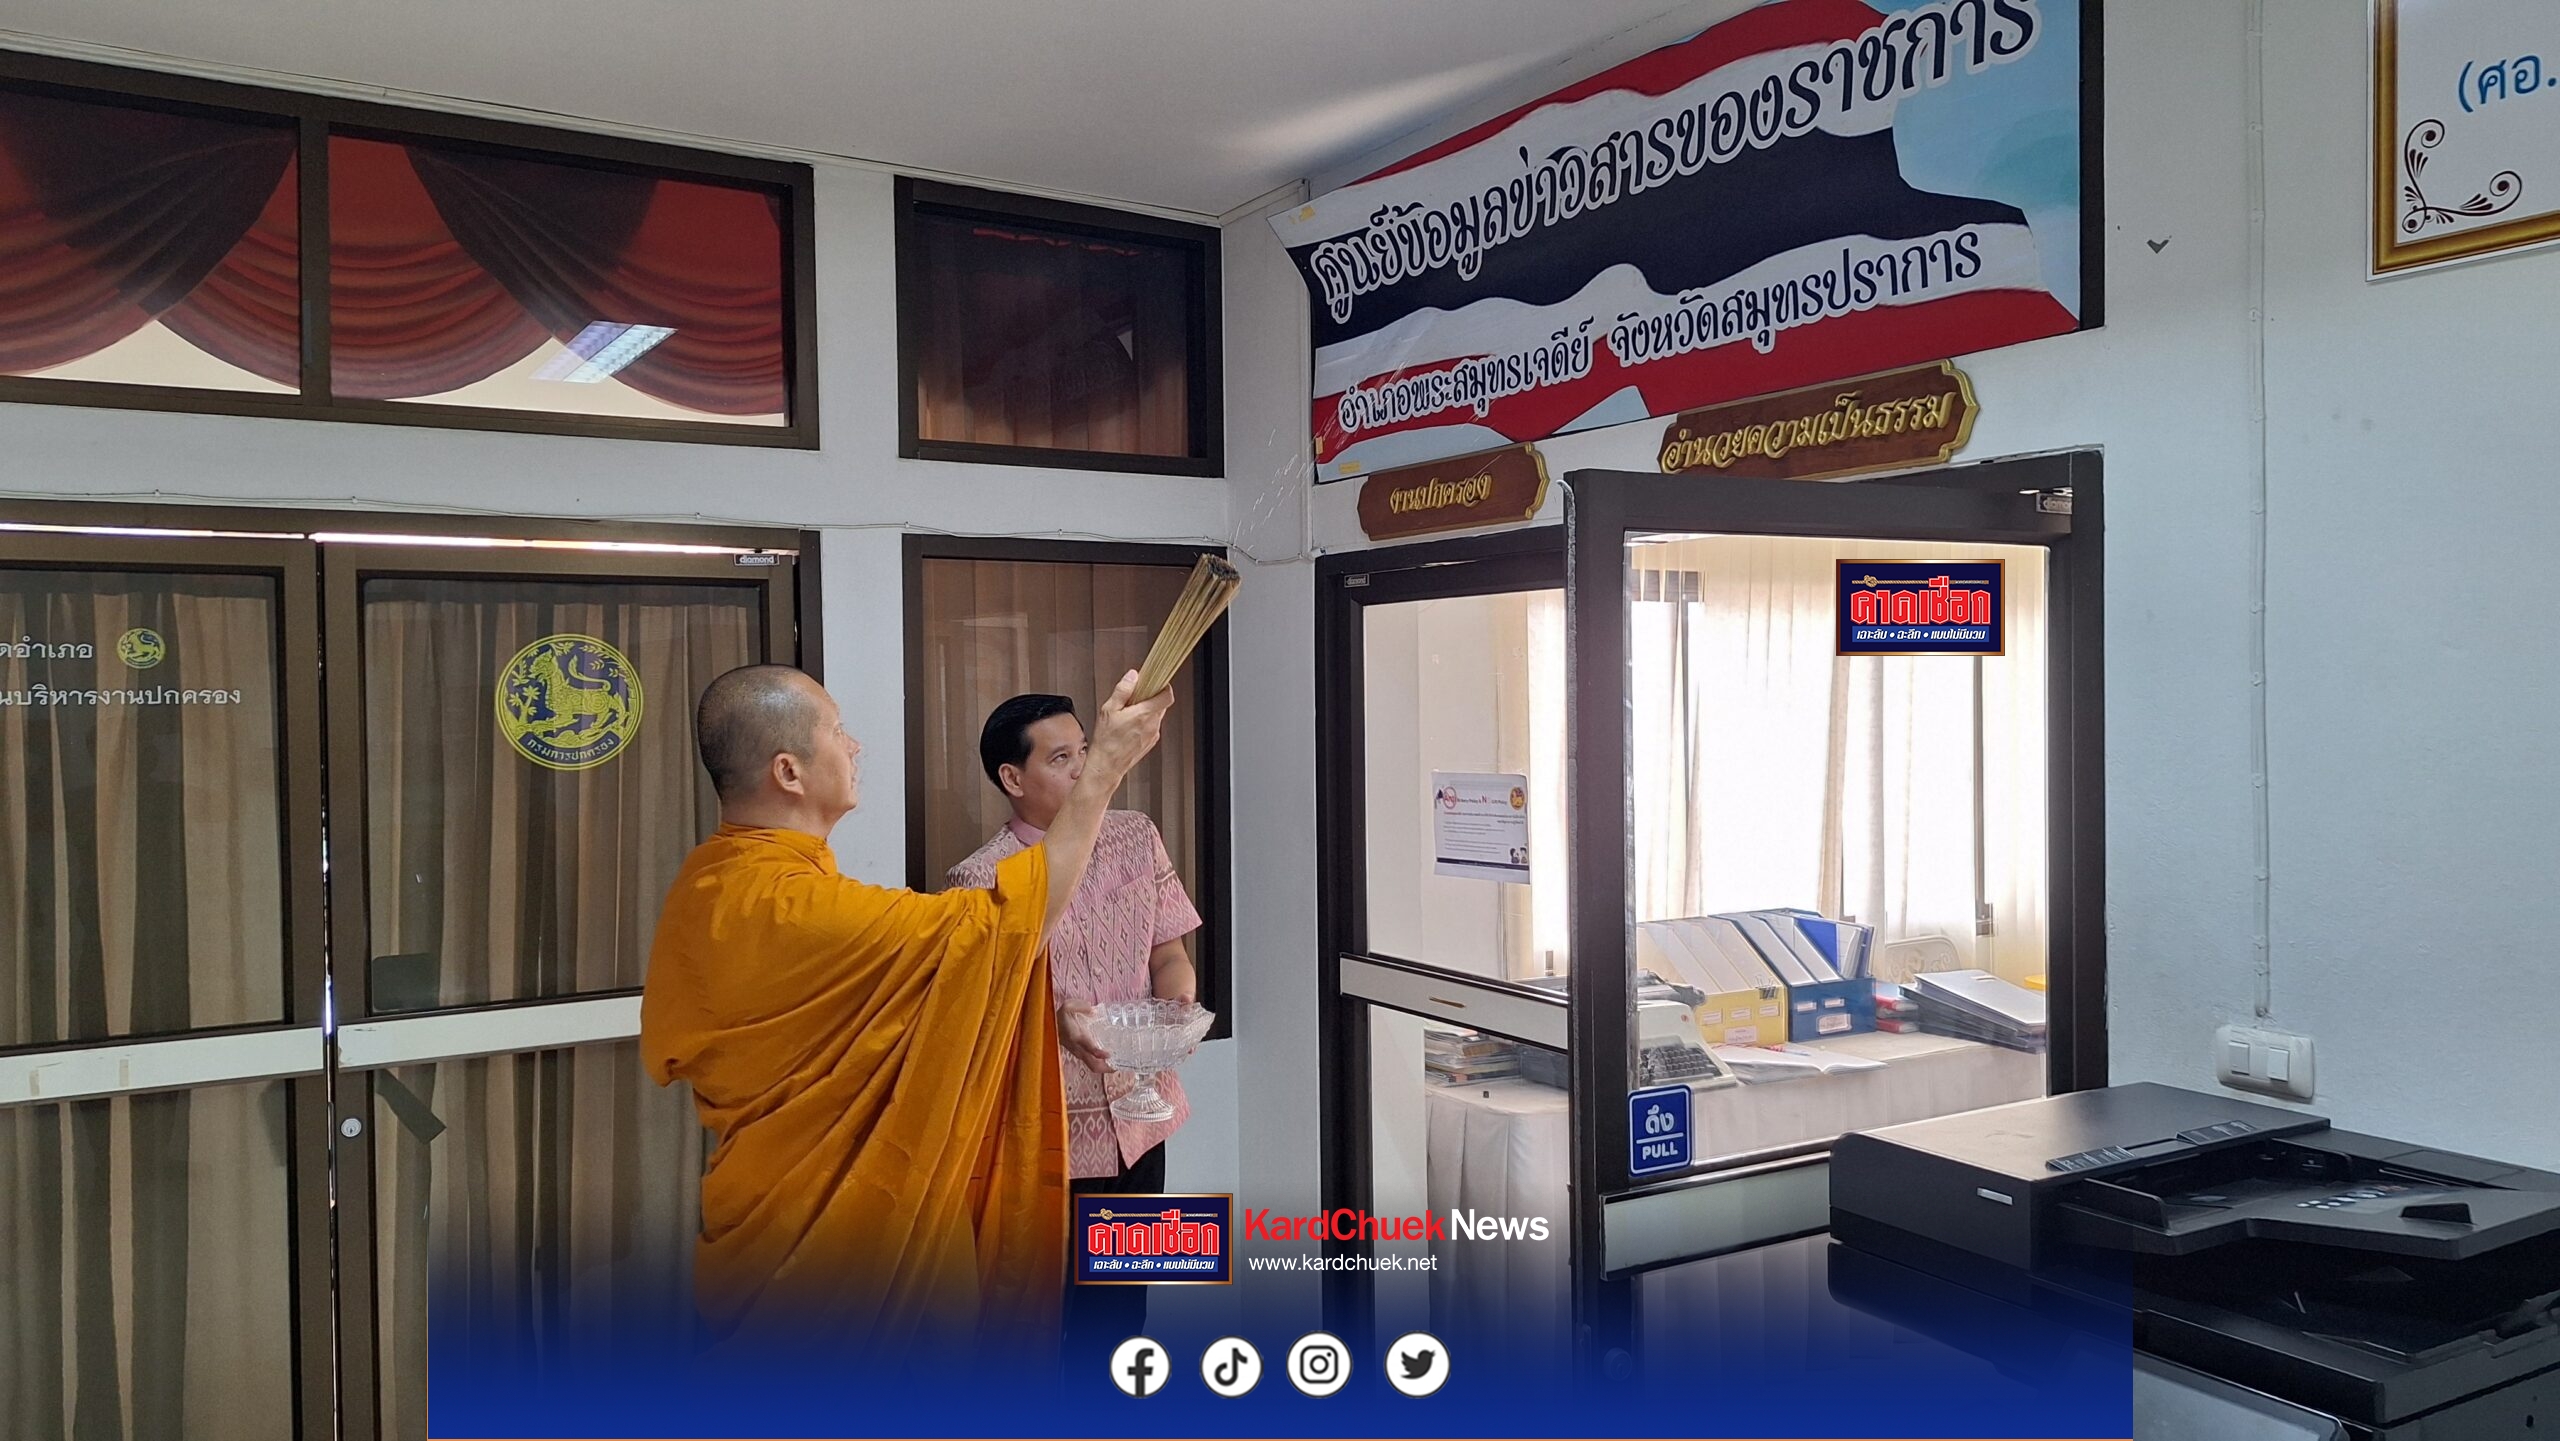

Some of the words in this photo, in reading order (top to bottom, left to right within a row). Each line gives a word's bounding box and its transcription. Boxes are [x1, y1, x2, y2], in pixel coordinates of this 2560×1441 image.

[1313, 0, 2034, 320] ศูนย์ข้อมูลข่าวสารของราชการ
[1340, 316, 1595, 428] อำเภอพระสมุทรเจดีย์
[1611, 231, 1982, 361] จังหวัดสมุทรปราการ
[1660, 391, 1957, 473] อำนวยความเป็นธรรม
[1389, 472, 1494, 514] งานปกครอง
[526, 738, 615, 761] กรมการปกครอง
[1645, 1104, 1675, 1134] ดึง
[1642, 1141, 1679, 1161] PULL
